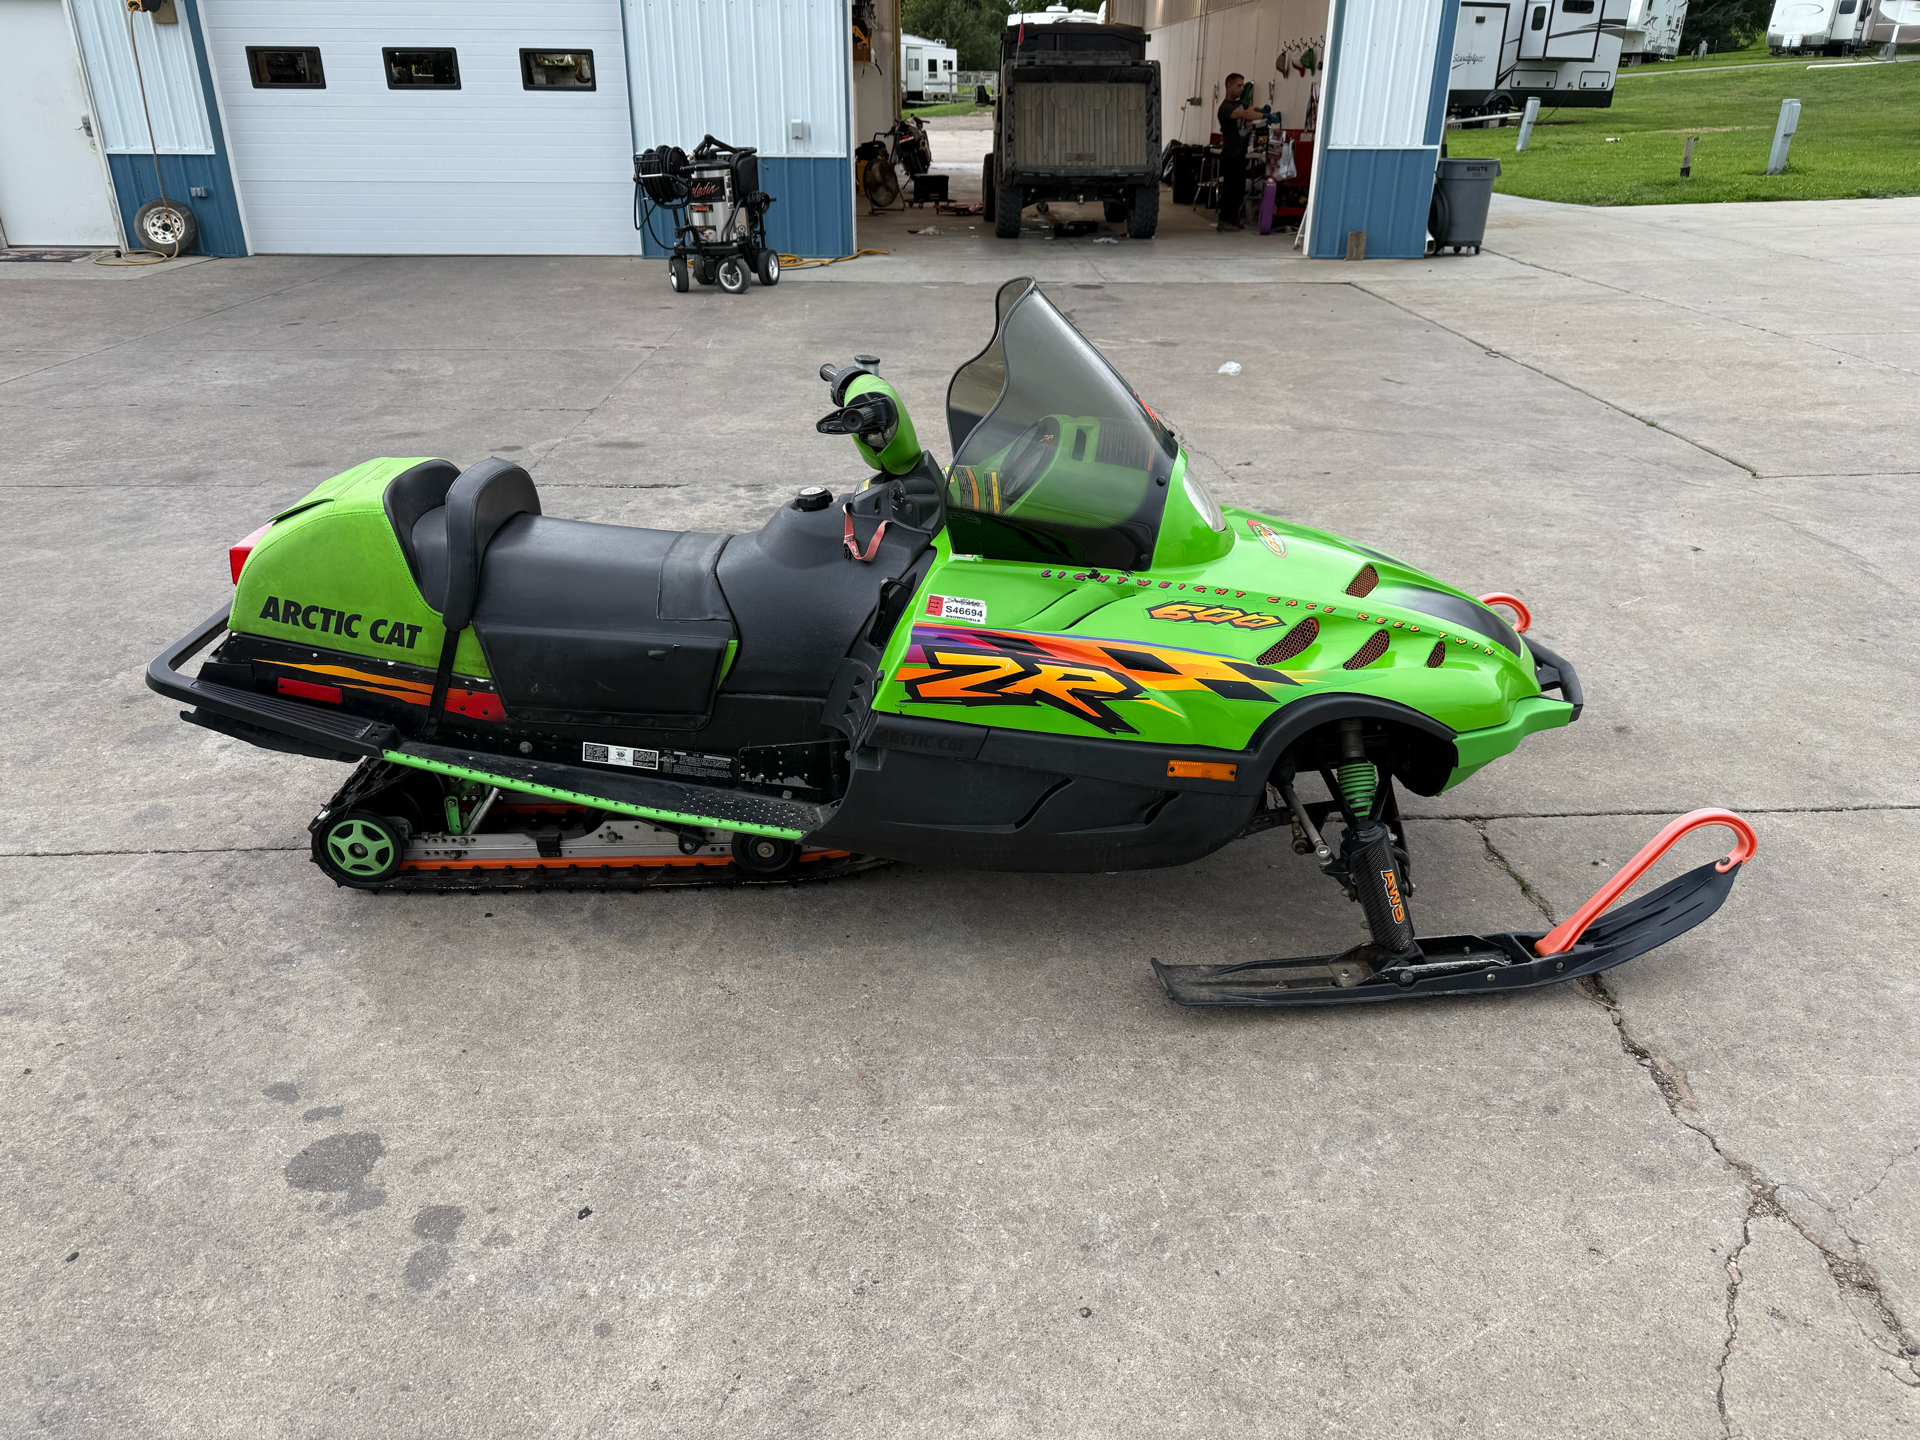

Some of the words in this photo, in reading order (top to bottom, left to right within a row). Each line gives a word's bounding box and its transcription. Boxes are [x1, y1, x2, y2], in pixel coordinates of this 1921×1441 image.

[259, 595, 362, 639] ARCTIC
[369, 618, 423, 650] CAT
[945, 605, 983, 618] S46694
[1040, 569, 1247, 599] LIGHTWEIGHT
[1266, 595, 1337, 614] CASE
[1356, 611, 1421, 633] REED
[1437, 630, 1495, 657] TWIN
[1147, 601, 1285, 630] 600
[905, 648, 1140, 731] ZR
[877, 729, 934, 749] ARCTIC
[937, 736, 967, 753] CAT
[1383, 871, 1405, 923] AWS
